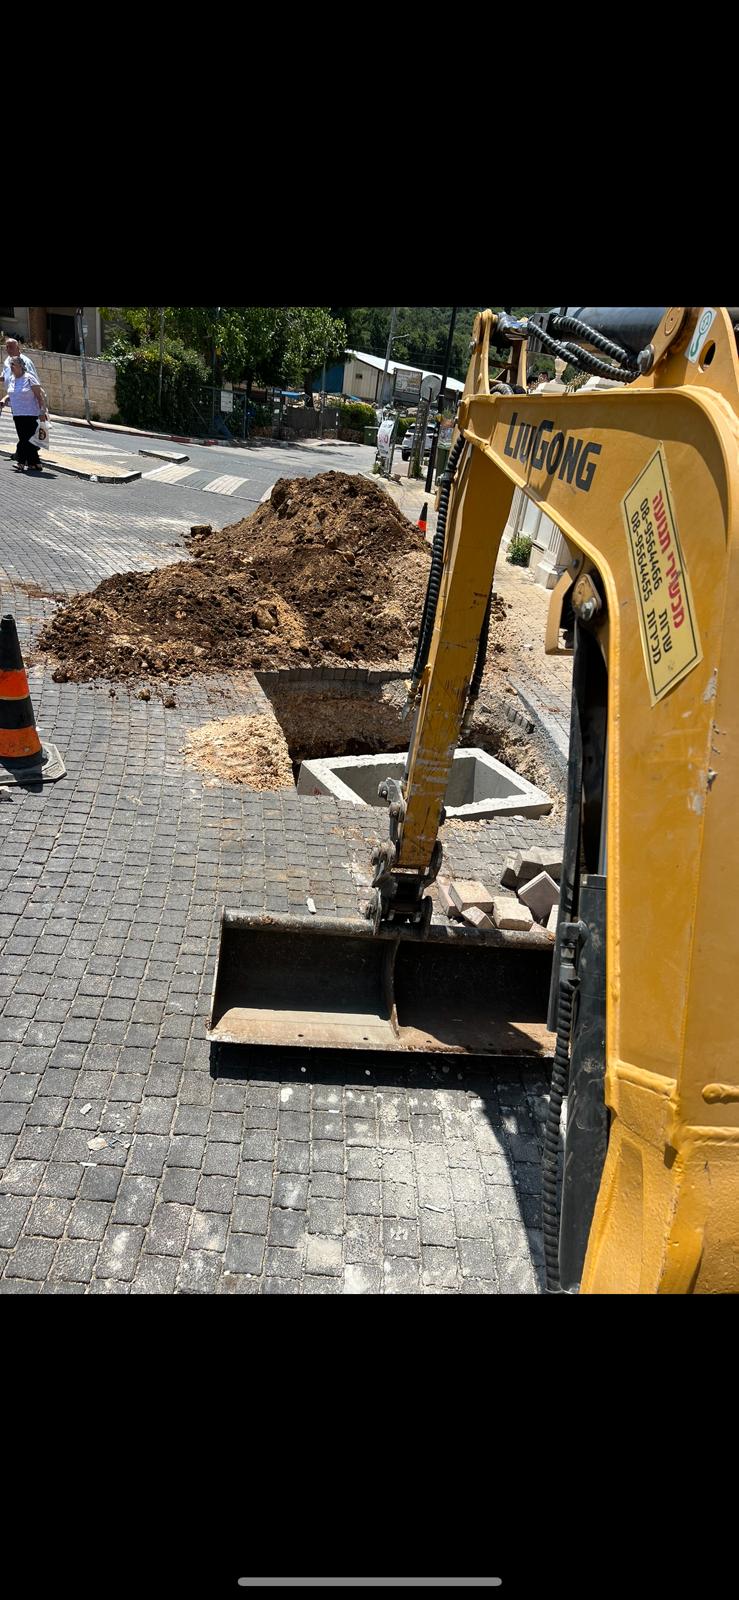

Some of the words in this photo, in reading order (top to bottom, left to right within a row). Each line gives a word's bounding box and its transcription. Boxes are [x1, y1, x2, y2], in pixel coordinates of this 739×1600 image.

[631, 511, 653, 602] 08-9564455
[640, 497, 662, 591] 08-9564466
[652, 488, 671, 555] תנועה
[665, 551, 685, 629] מכשירי
[647, 608, 662, 665] מכירות
[658, 608, 673, 653] שרות
